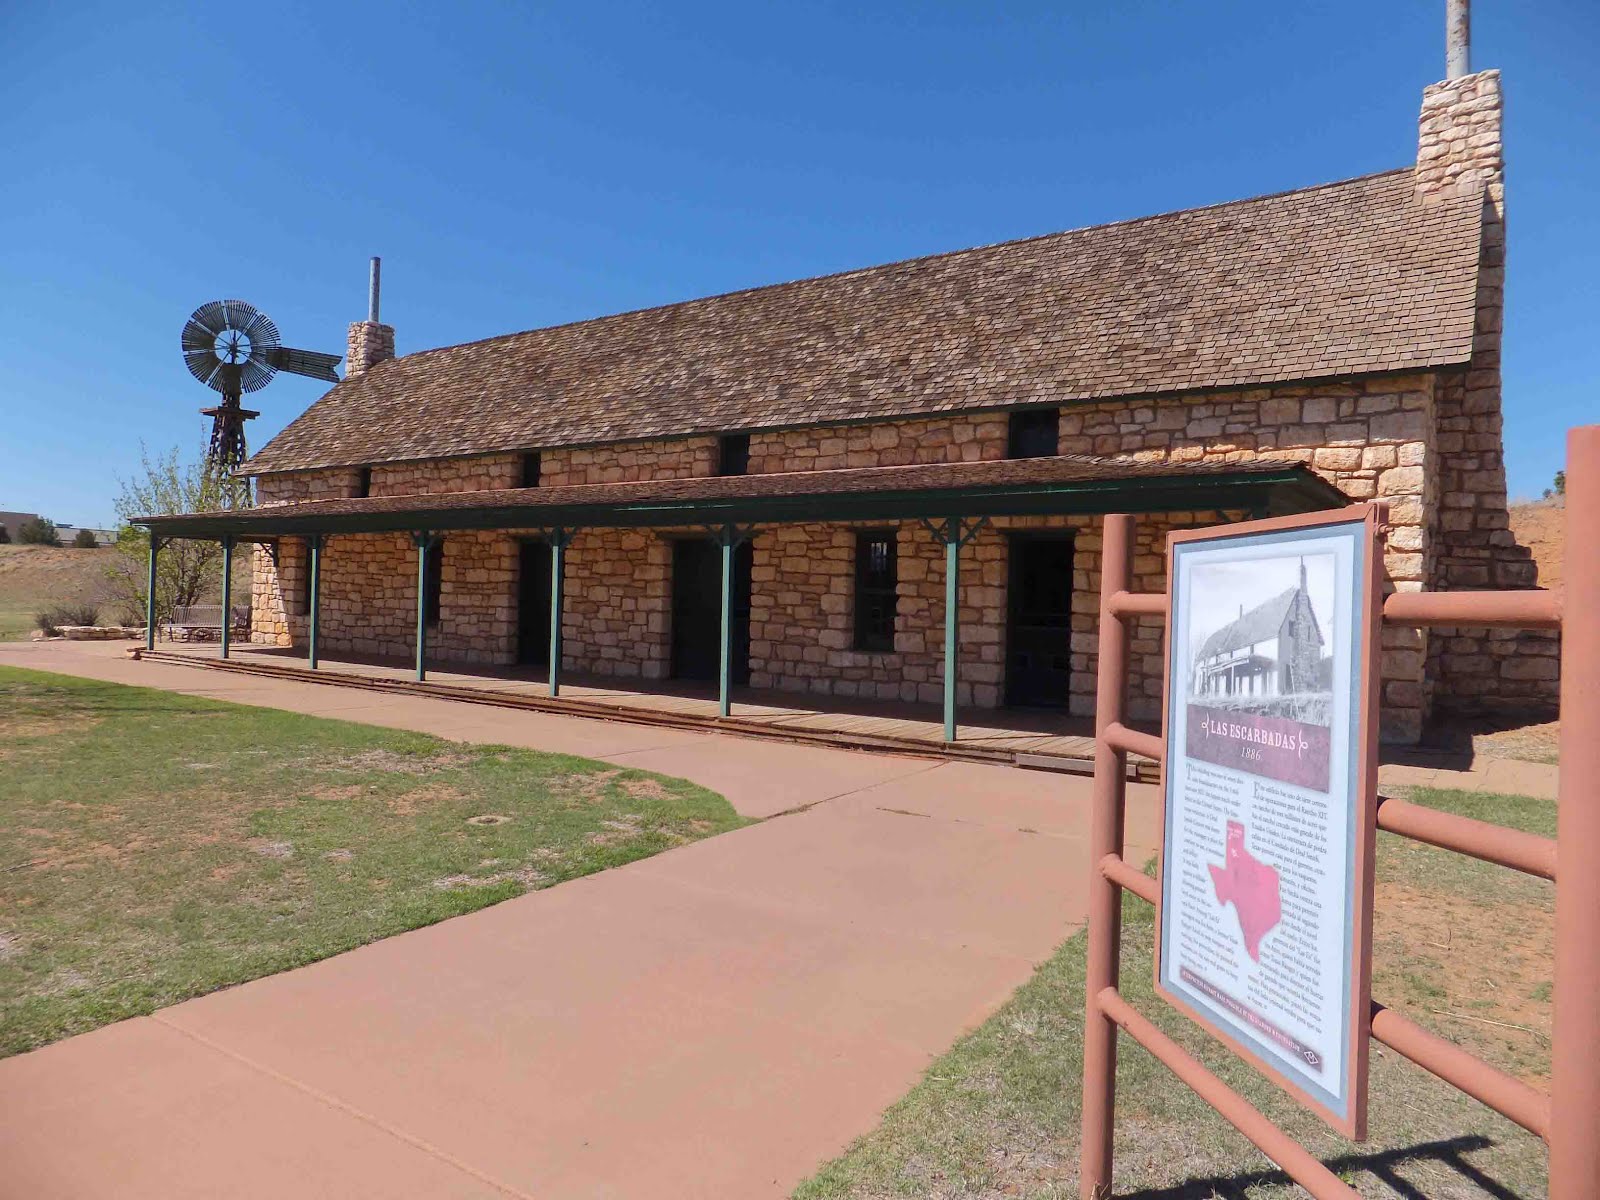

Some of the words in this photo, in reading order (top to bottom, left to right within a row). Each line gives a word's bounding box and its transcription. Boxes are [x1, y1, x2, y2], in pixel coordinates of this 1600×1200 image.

[1210, 720, 1228, 737] LAS
[1229, 723, 1296, 750] ESCARBADAS
[1241, 747, 1262, 761] 1886
